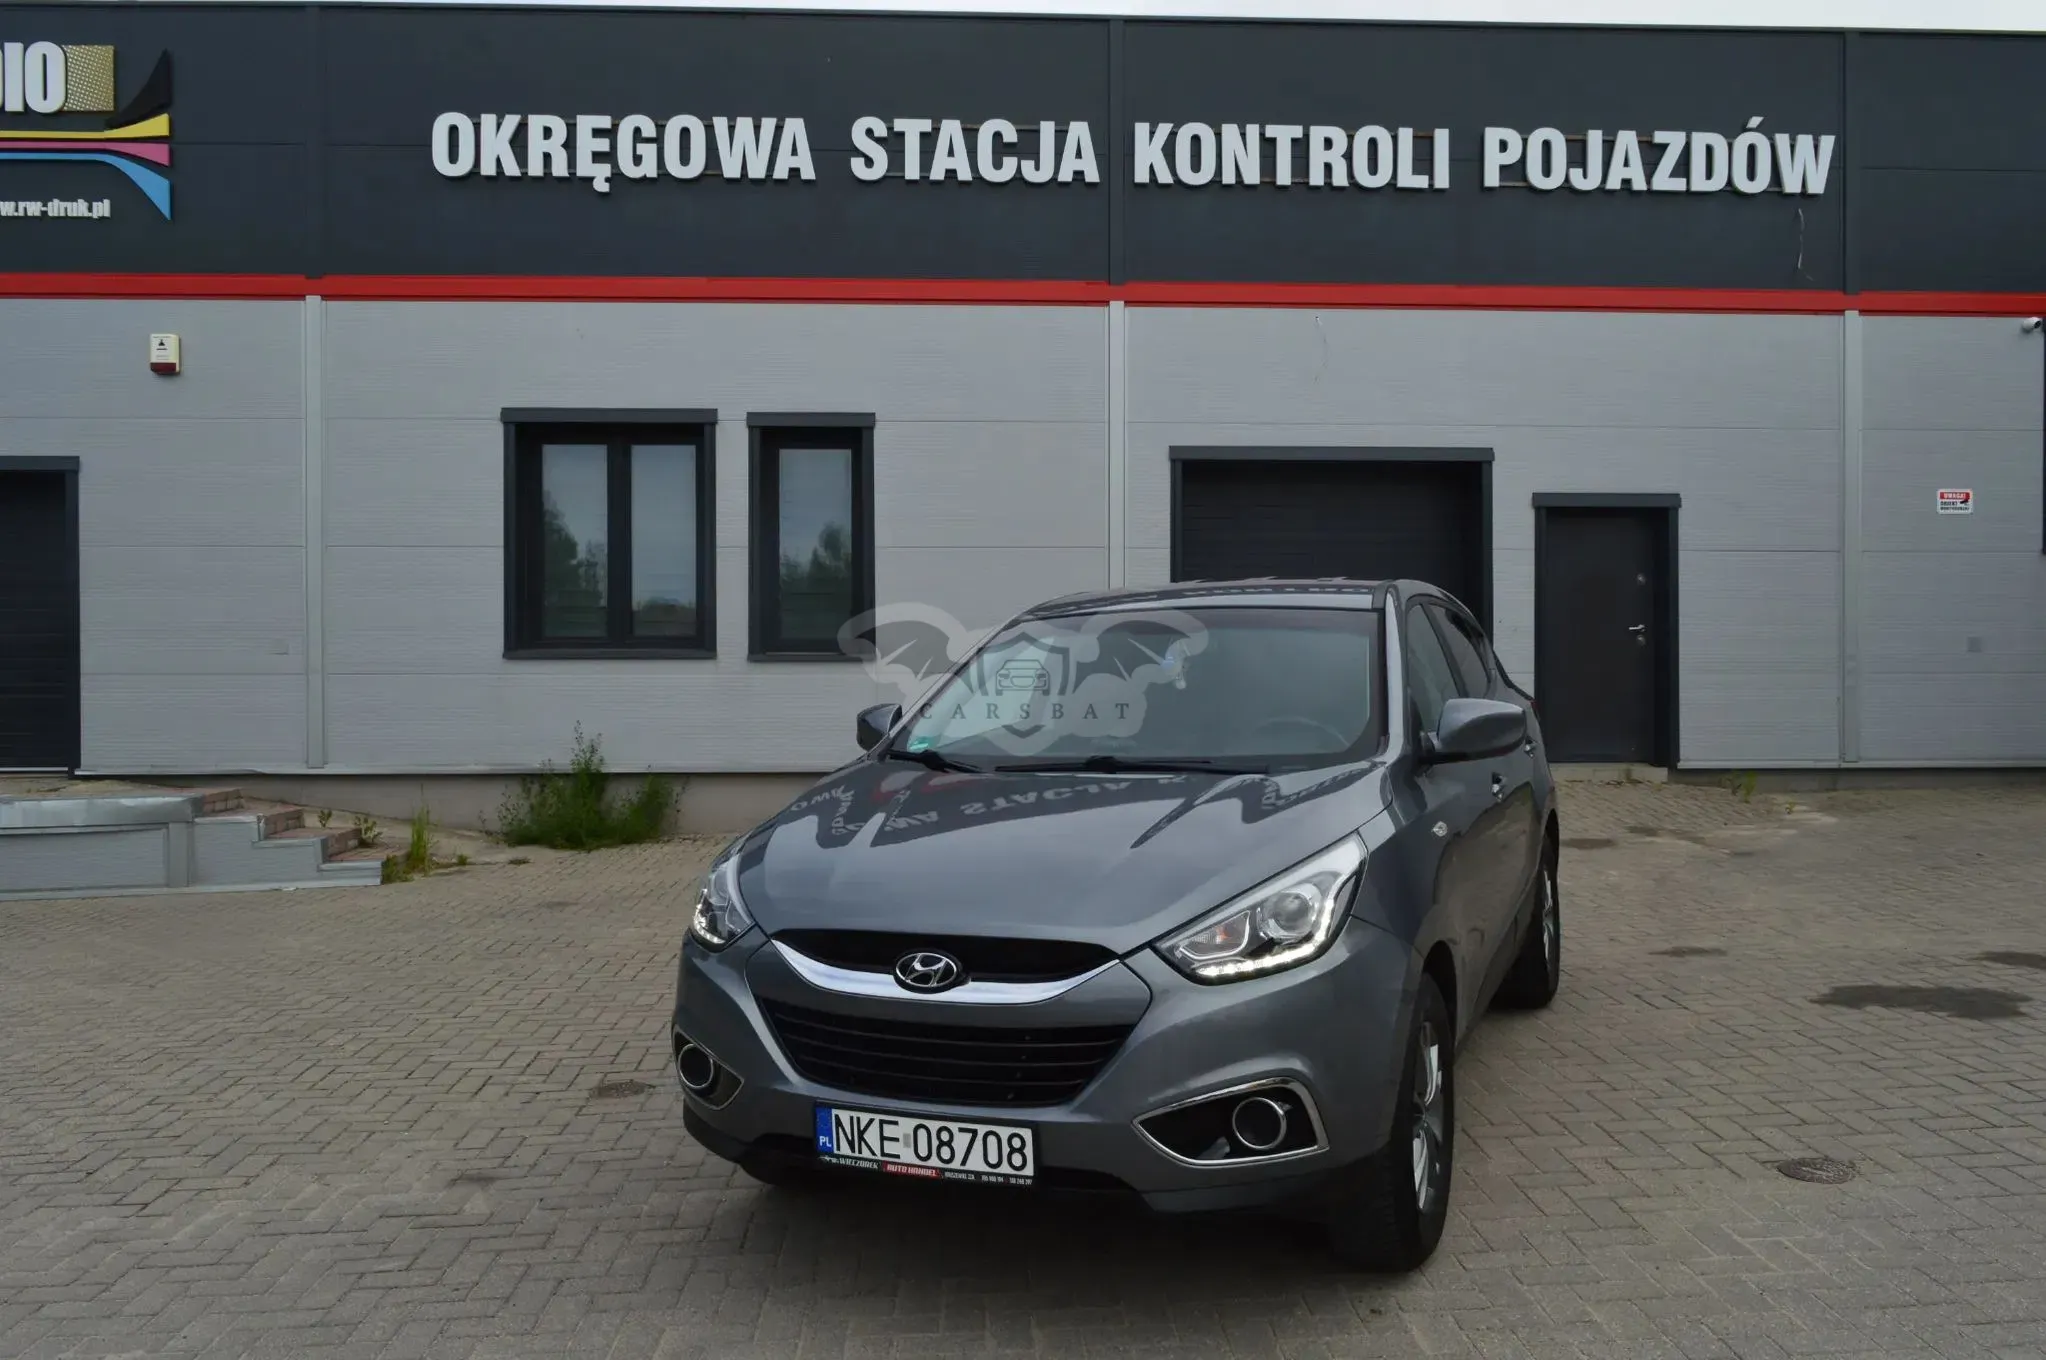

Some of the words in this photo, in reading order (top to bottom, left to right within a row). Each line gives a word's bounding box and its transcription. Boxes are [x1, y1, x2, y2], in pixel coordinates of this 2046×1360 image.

[0, 41, 66, 113] IO
[431, 112, 816, 193] OKRĘGOWA
[850, 116, 1100, 183] STACJA
[1133, 122, 1450, 190] KONTROLI
[1483, 117, 1836, 195] POJAZDÓW
[0, 198, 110, 217] w.rw-druk.pl
[819, 1136, 832, 1148] PL
[834, 1114, 901, 1159] NKE
[912, 1123, 1028, 1172] 08708
